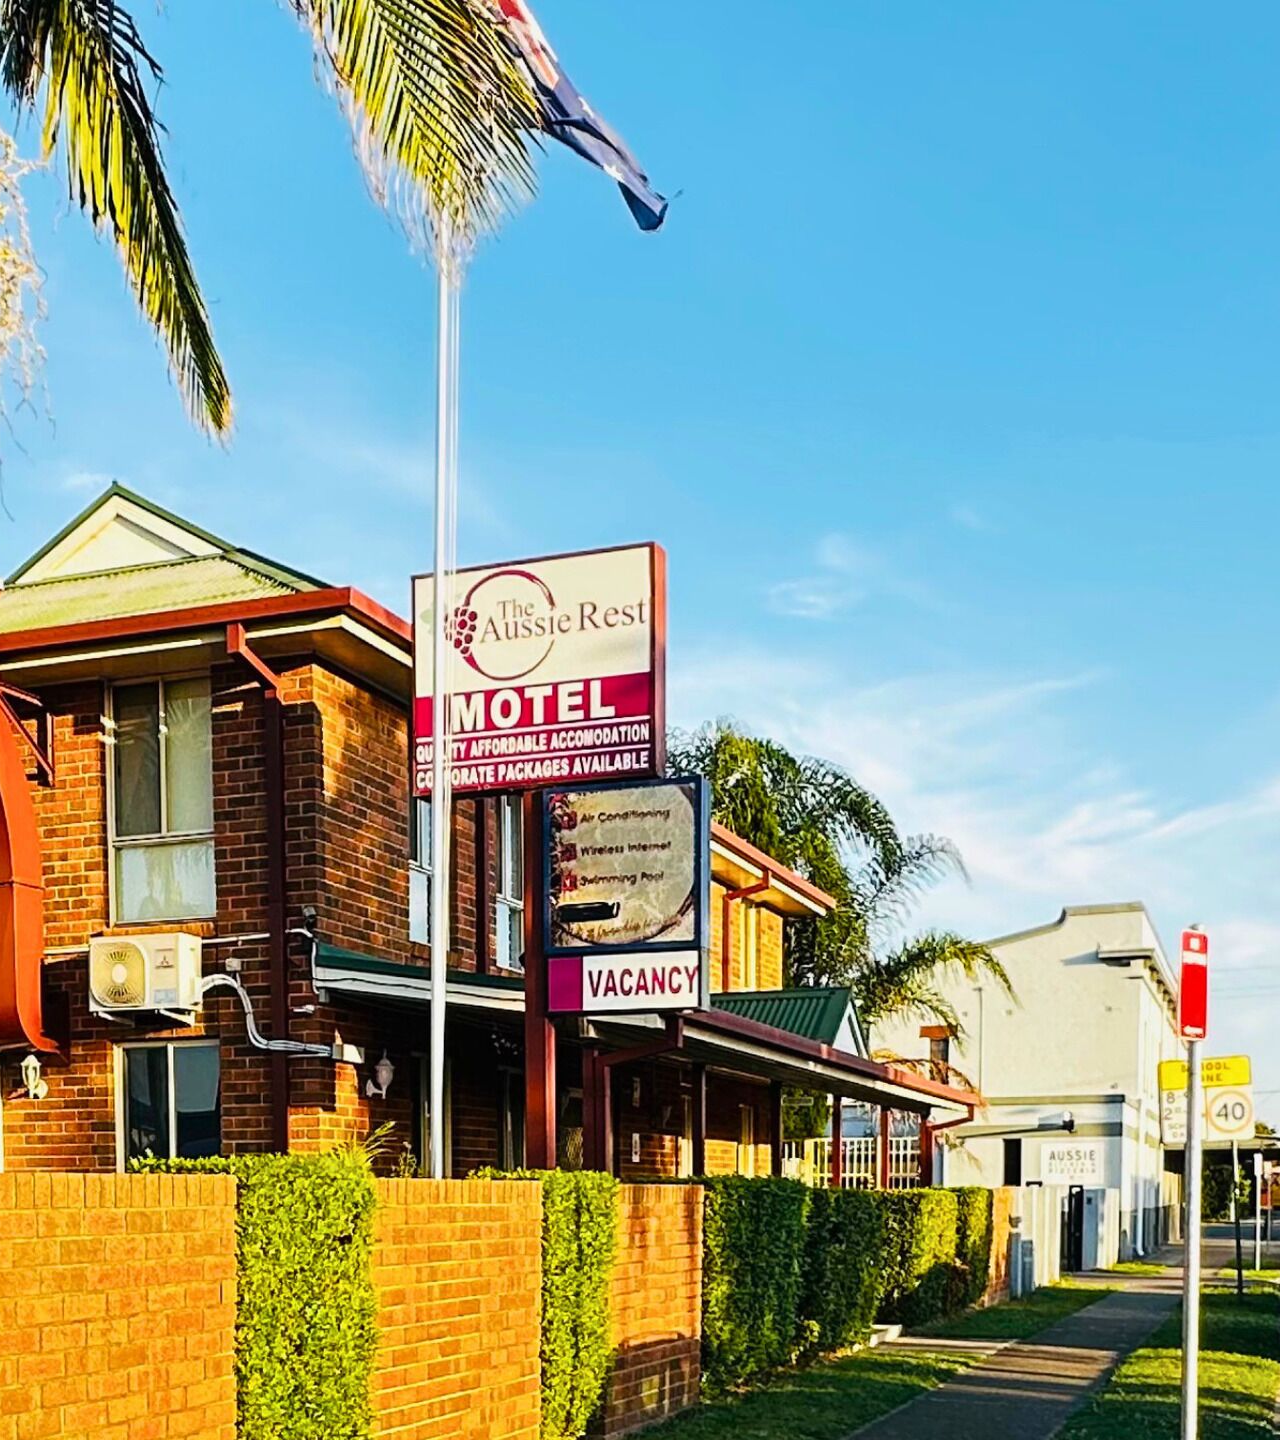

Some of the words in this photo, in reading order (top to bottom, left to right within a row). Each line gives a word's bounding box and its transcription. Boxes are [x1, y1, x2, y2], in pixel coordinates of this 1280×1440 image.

[497, 599, 535, 620] The
[480, 609, 571, 644] Aussie
[578, 597, 648, 631] Rest
[451, 679, 616, 733] MOTEL
[469, 732, 549, 758] AFFORDABLE
[550, 723, 650, 750] ACCOMODATION
[497, 758, 570, 782] PACKAGES
[571, 750, 650, 776] AVAILABLE
[580, 812, 595, 823] Air
[598, 808, 671, 823] Conditioning
[580, 844, 625, 857] Wireless
[627, 841, 672, 854] Internet
[580, 873, 638, 886] Swimming
[640, 870, 665, 882] Pool
[587, 964, 700, 998] VACANCY
[1215, 1102, 1246, 1122] 40
[1049, 1149, 1097, 1161] AUSSIE
